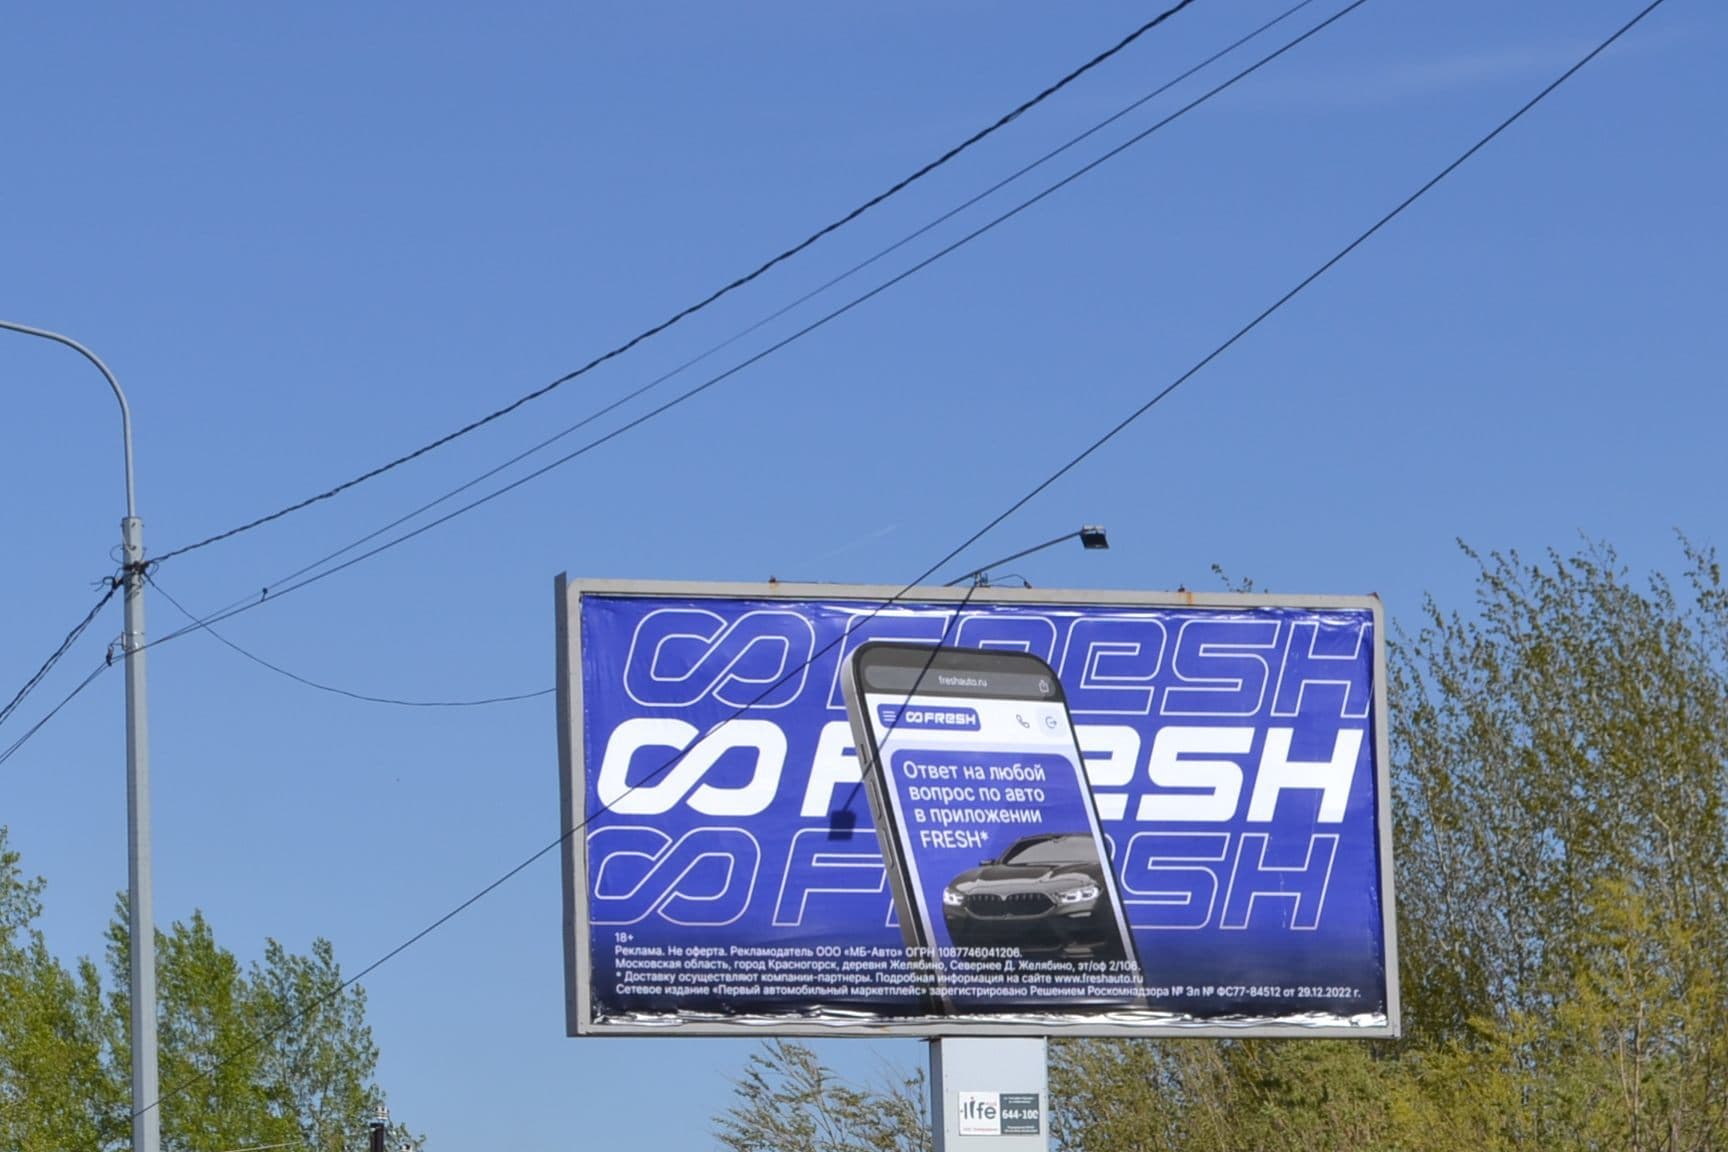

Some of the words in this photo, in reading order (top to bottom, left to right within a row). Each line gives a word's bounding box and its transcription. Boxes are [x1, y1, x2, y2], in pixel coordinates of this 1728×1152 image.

[903, 760, 958, 779] Ответ
[964, 764, 986, 780] на
[989, 764, 1046, 783] любой
[909, 785, 975, 805] вопрос
[979, 787, 1001, 803] по
[1005, 788, 1045, 802] авто
[915, 808, 926, 823] в
[930, 808, 1042, 828] приложении
[615, 932, 634, 943] 18+
[615, 945, 665, 956] Реклама.
[668, 945, 683, 956] Не
[685, 946, 728, 958] оферта.
[730, 946, 814, 958] Рекламодатель
[816, 946, 842, 957] ООО
[844, 946, 903, 957] «МБ-Авто»
[905, 947, 936, 957] ОГРН
[615, 958, 682, 969] Московская
[684, 959, 732, 971] область,
[734, 961, 766, 971] город
[768, 960, 840, 971] Красногорск,
[842, 961, 888, 971] деревня
[890, 960, 948, 971] Желябино,
[950, 960, 1002, 972] Севернее
[1003, 961, 1016, 972] Д.
[1018, 961, 1076, 972] Желябино,
[1077, 961, 1107, 972] эт/оф
[624, 971, 676, 983] Доставку
[678, 973, 759, 983] осуществляют
[761, 973, 873, 984] компании-партнеры.
[875, 972, 935, 984] Подробная
[937, 973, 1005, 984] информация
[1006, 974, 1019, 983] на
[1021, 973, 1052, 983] сайте
[1054, 973, 1144, 984] www.freshauto.ru
[616, 984, 662, 994] Сетевое
[664, 986, 710, 996] издание
[712, 984, 761, 996] «Первый
[763, 984, 848, 995] автомобильный
[850, 986, 927, 997] маркетплейс»
[929, 987, 1028, 997] зарегистрировано
[1030, 985, 1085, 996] Решением
[1087, 985, 1170, 998] Роскомнадзора
[1171, 986, 1184, 996] №
[1202, 986, 1215, 997] №
[1283, 988, 1295, 997] от
[1297, 986, 1352, 998] 29.12.2022
[1353, 988, 1361, 998] г.
